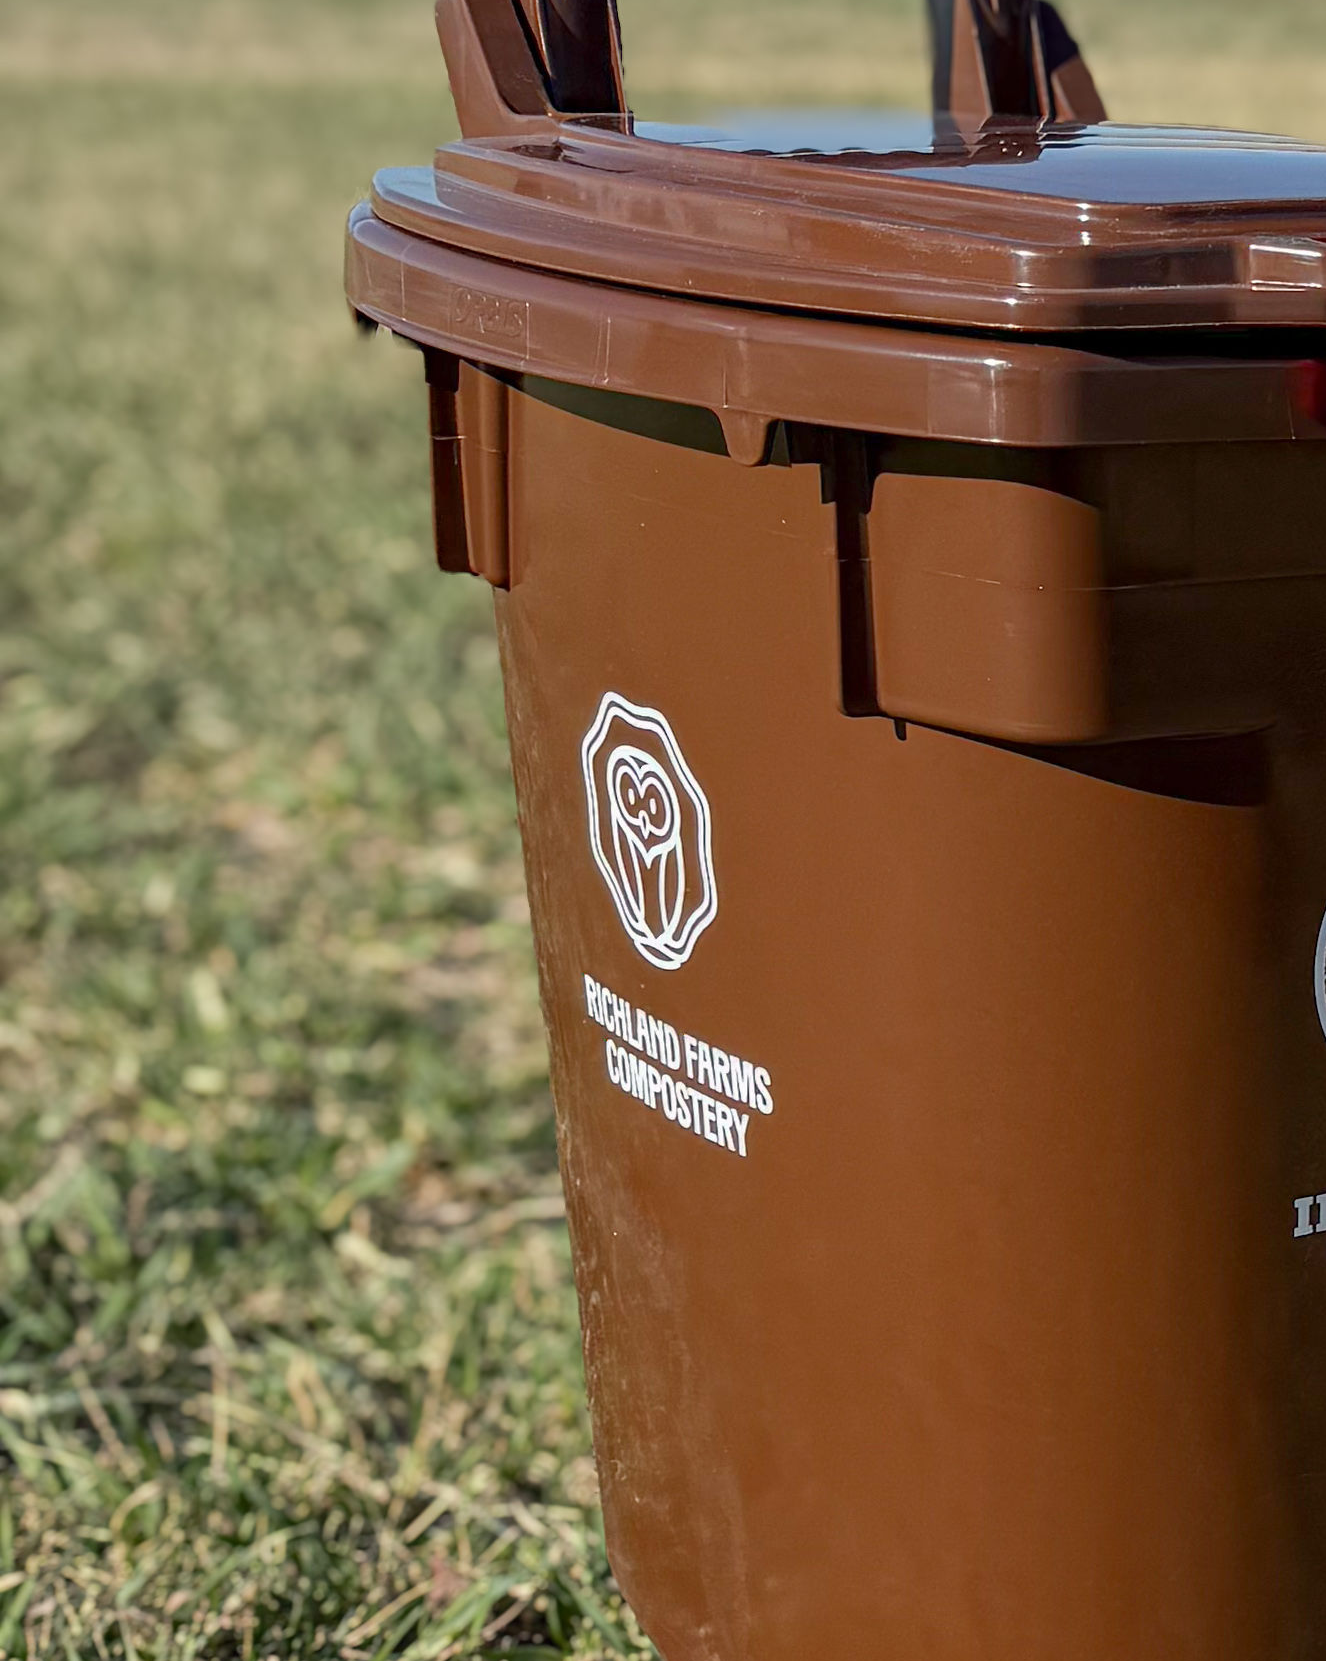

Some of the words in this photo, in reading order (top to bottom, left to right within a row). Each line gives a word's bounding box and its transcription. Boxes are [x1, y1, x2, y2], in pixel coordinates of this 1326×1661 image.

[583, 974, 682, 1071] RICHLAND
[683, 1033, 774, 1115] FARMS
[604, 1038, 750, 1157] COMPOSTERY
